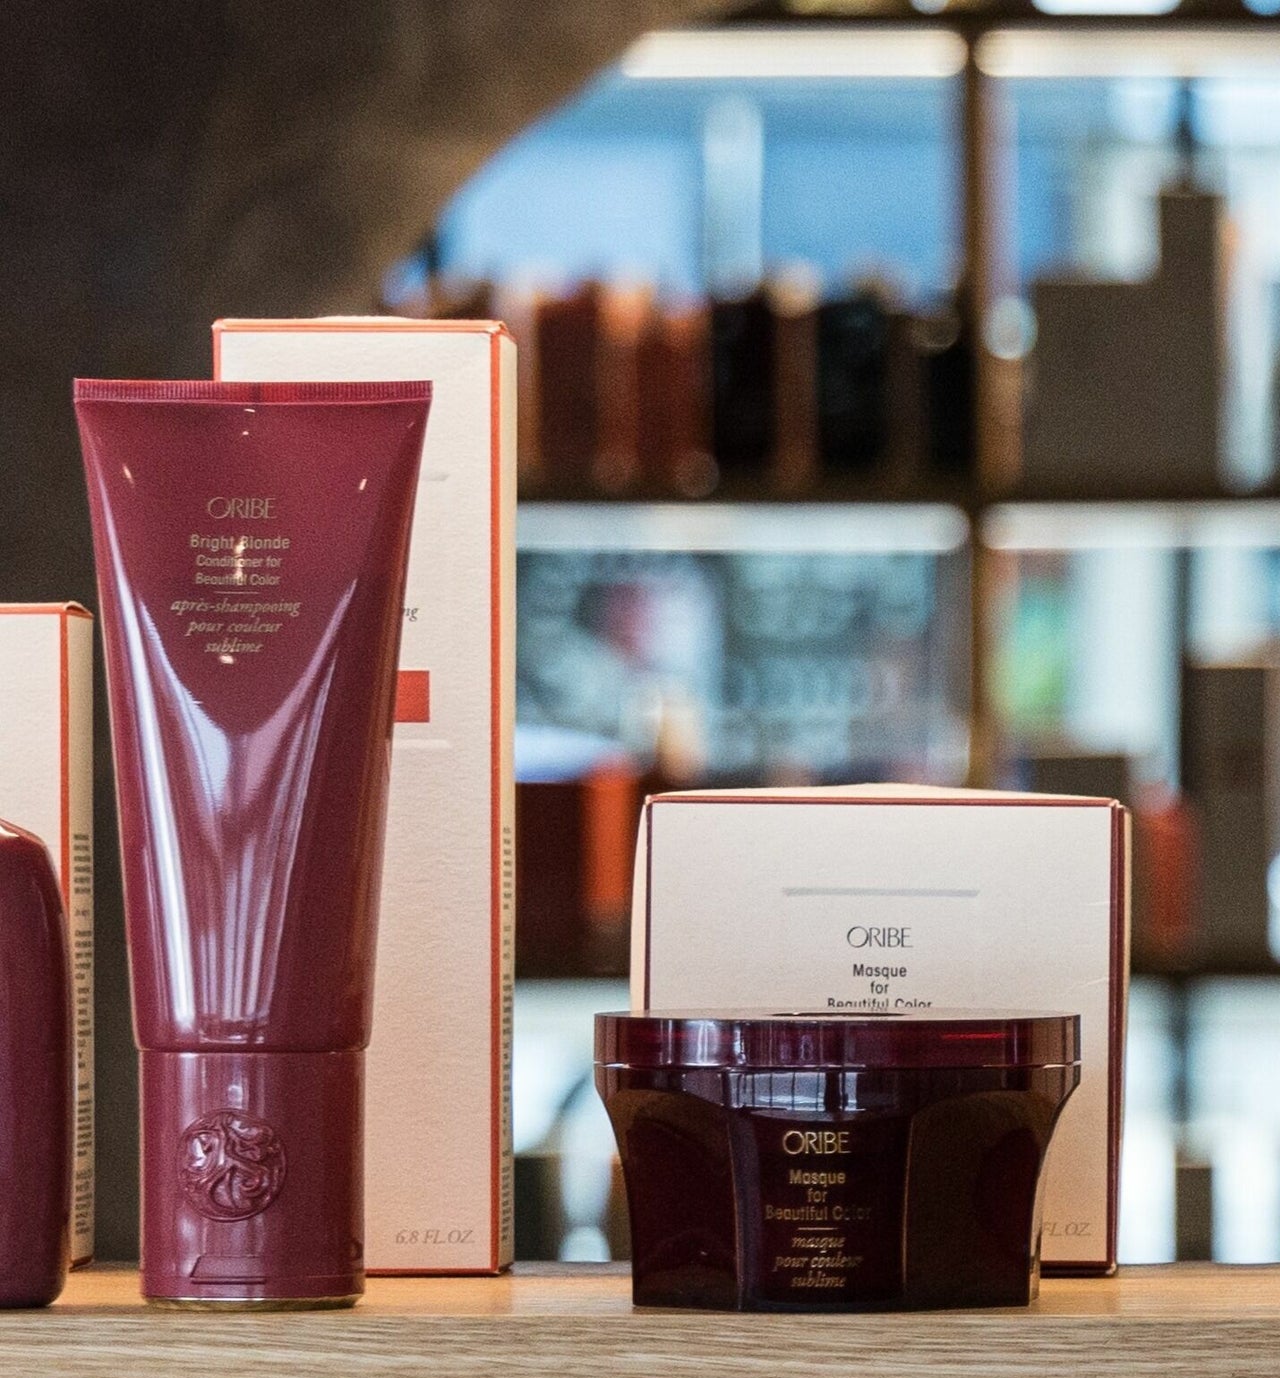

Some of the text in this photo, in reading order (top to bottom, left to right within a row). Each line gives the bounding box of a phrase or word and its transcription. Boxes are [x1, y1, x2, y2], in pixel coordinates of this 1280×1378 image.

[208, 496, 278, 519] ORIBE
[190, 534, 292, 552] Bright Blonde
[266, 555, 282, 568] for
[250, 573, 280, 586] Color
[170, 598, 302, 617] après-shampooing
[184, 617, 283, 637] pour couleur
[204, 637, 263, 653] sublime
[847, 926, 914, 948] ORIBE
[853, 963, 908, 980] Masque
[870, 981, 890, 994] for
[783, 1130, 851, 1155] ORIBE
[789, 1169, 847, 1188] Masque
[807, 1188, 828, 1203] for
[765, 1204, 828, 1221] Beautiful
[791, 1237, 847, 1254] masque
[773, 1256, 809, 1272] pour
[791, 1270, 847, 1288] sublime
